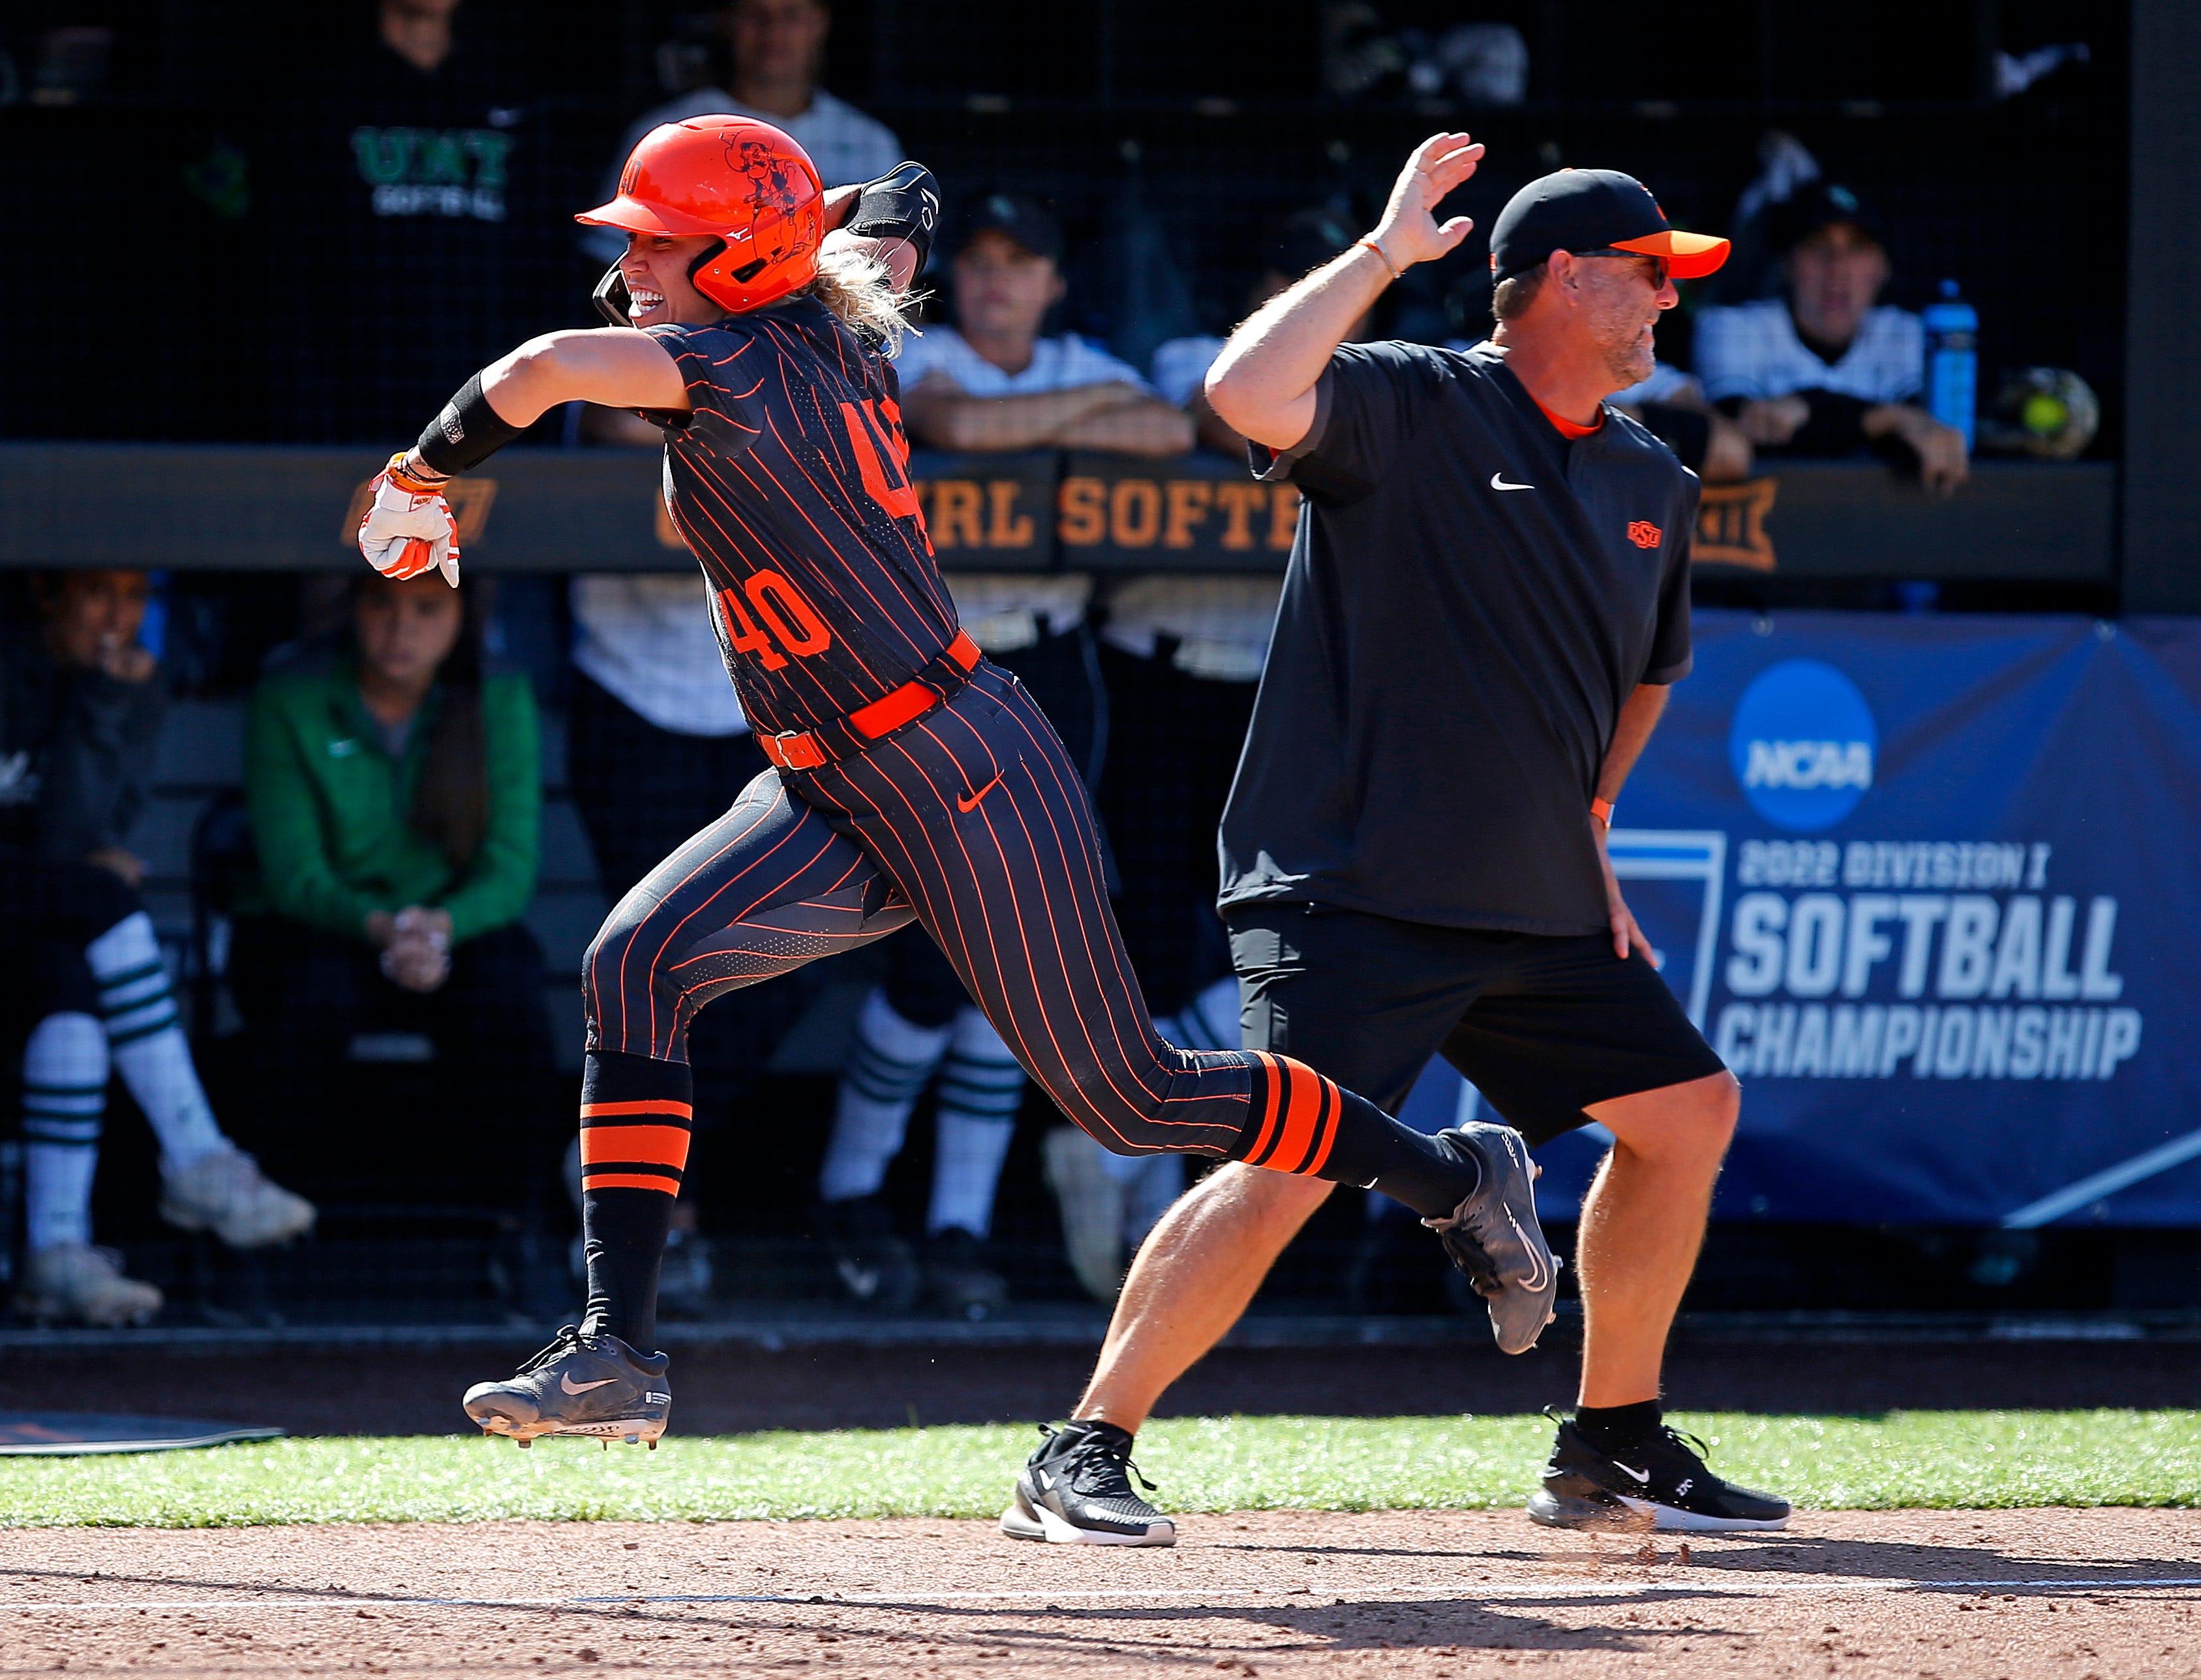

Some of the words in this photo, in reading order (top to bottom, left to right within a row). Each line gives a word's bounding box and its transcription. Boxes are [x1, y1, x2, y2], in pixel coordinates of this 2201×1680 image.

[718, 569, 831, 671] 40
[1746, 741, 1872, 789] NCAA
[1738, 839, 1838, 887] 2022
[1844, 840, 2025, 889] DIVISION
[2027, 842, 2053, 890] I
[1725, 892, 2123, 1001] SOFTBALL
[1714, 1003, 2144, 1080] CHAMPIONSHIP
